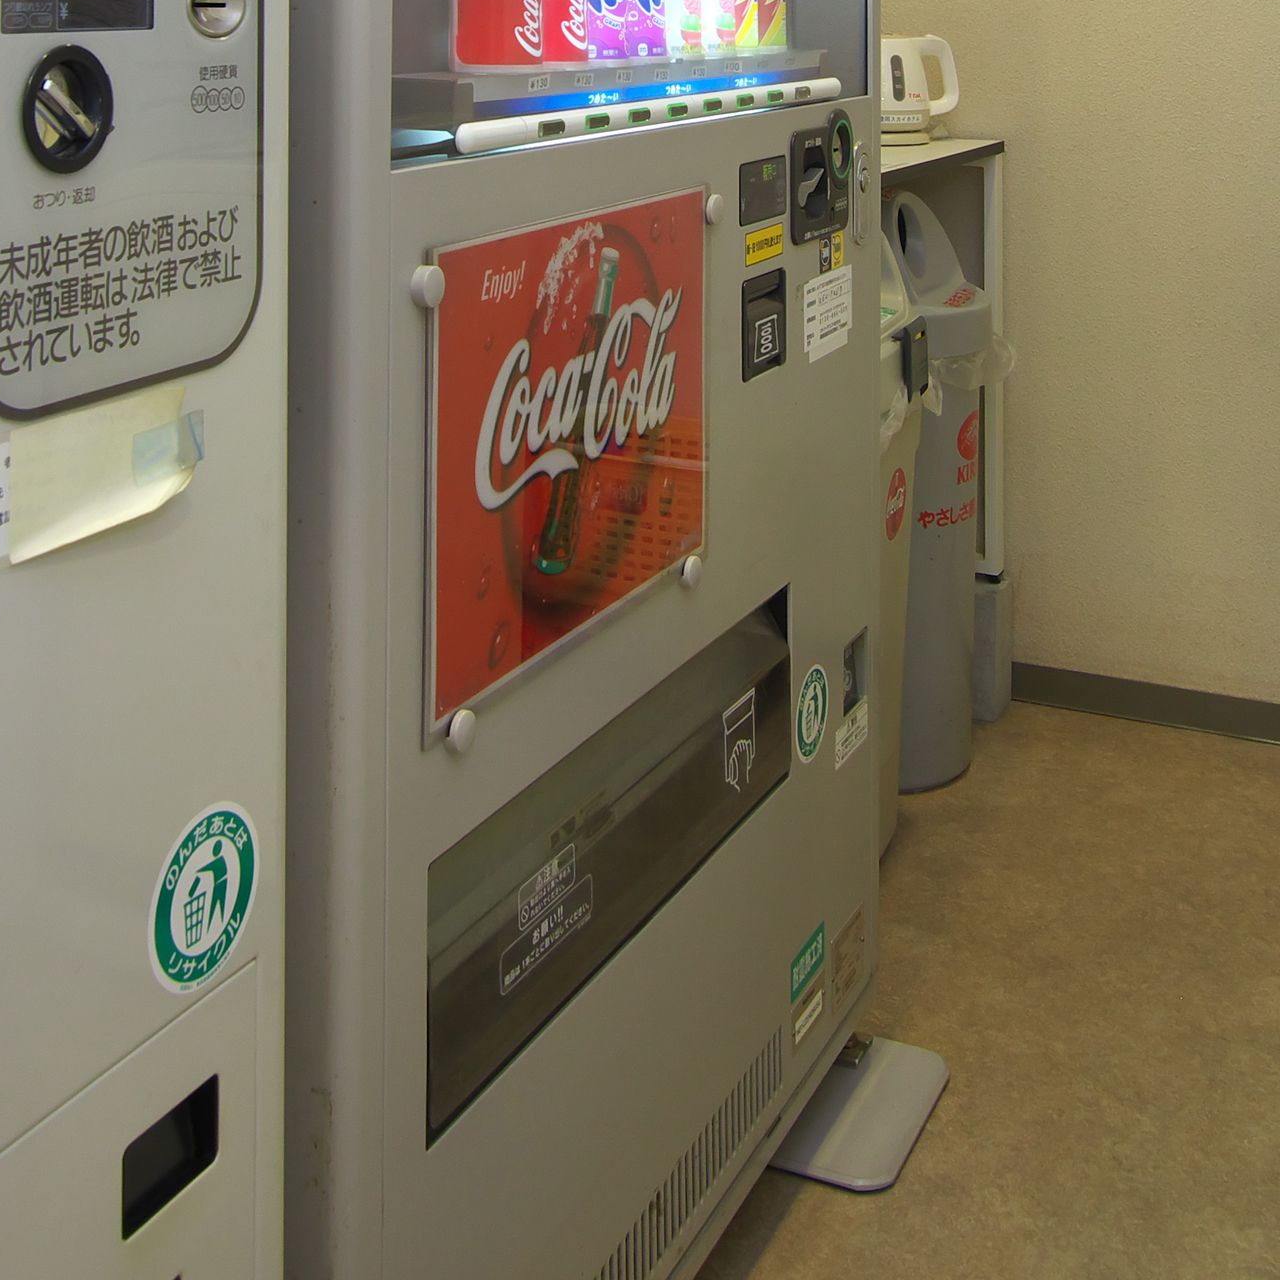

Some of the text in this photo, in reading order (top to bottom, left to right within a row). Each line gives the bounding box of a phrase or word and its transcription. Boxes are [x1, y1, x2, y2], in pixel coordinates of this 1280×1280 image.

[59, 1, 69, 21] ¥
[199, 64, 238, 81] 使用硬貨
[530, 77, 548, 89] ¥130
[576, 74, 592, 85] ¥130
[32, 186, 96, 210] おつり・返却
[481, 260, 526, 303] Enjoy!
[760, 322, 773, 355] 1000
[475, 285, 683, 512] Coca-Cola
[165, 815, 248, 891] のんだあとは
[167, 912, 241, 980] リサイクル
